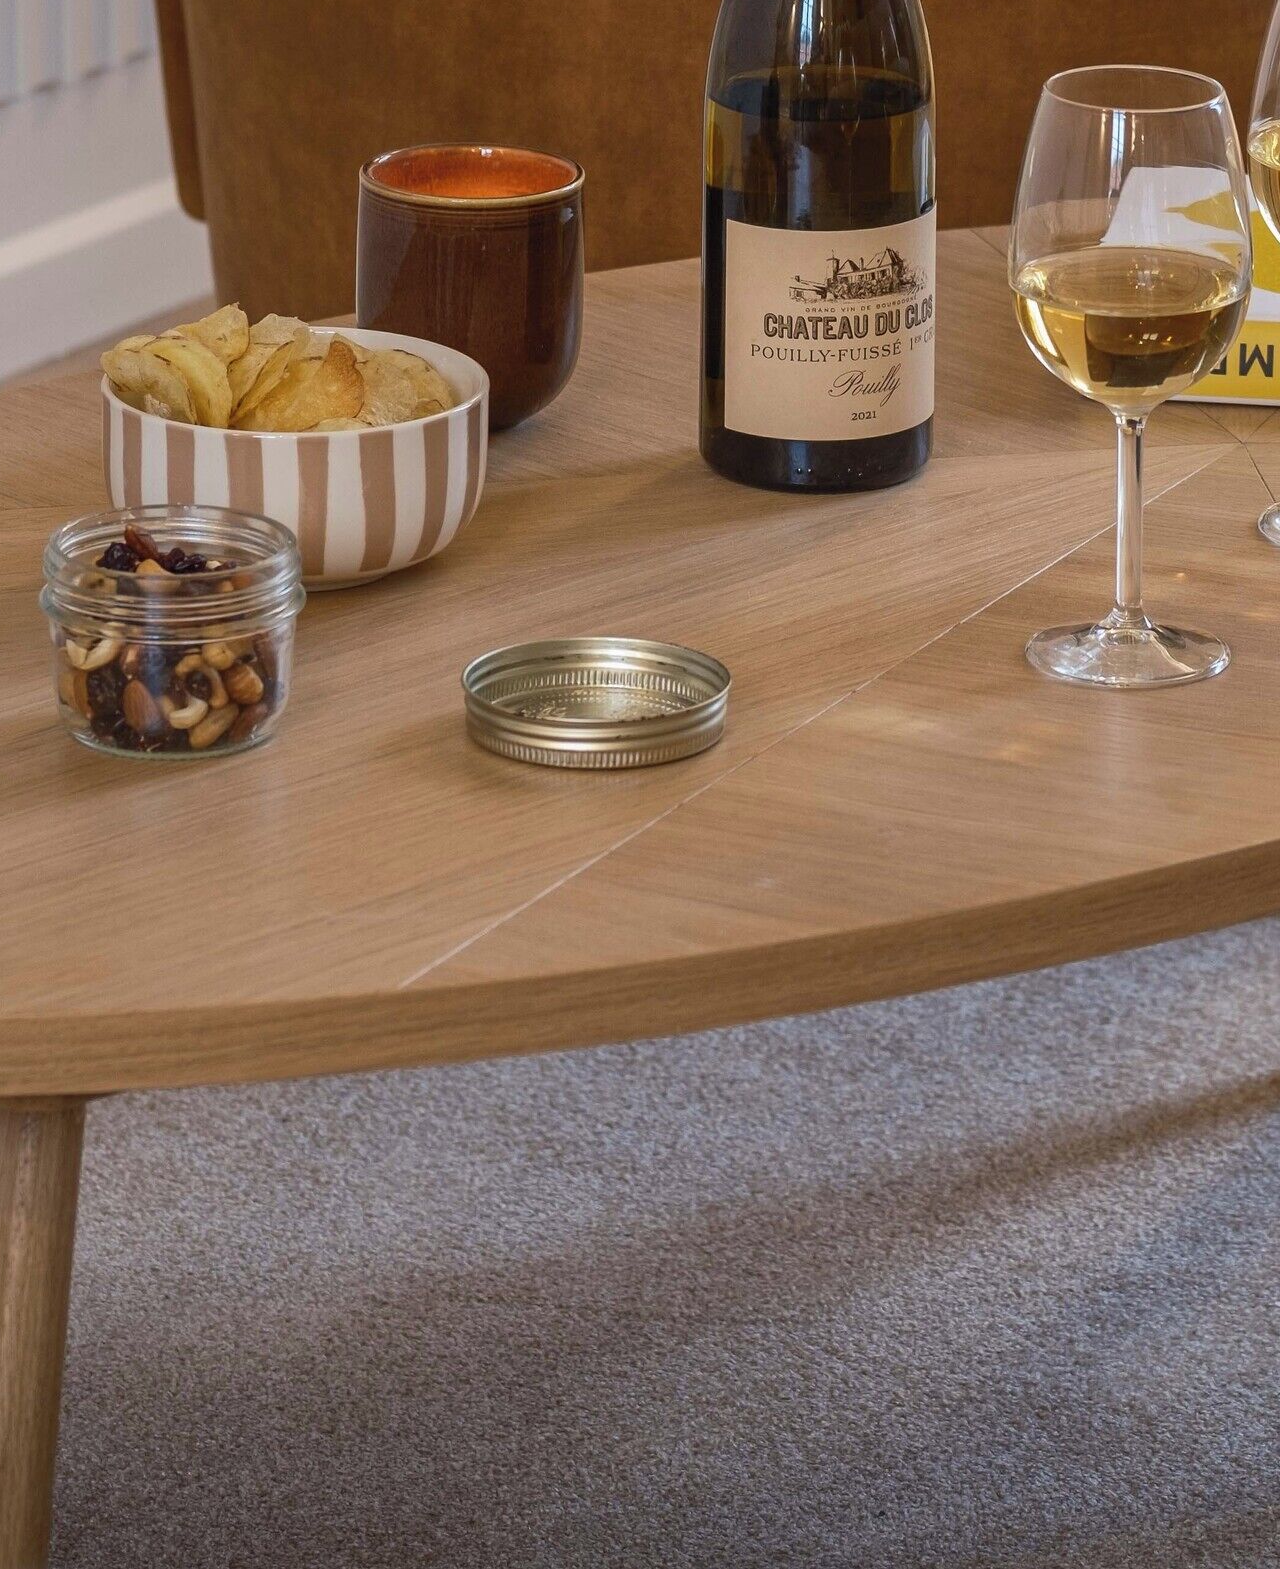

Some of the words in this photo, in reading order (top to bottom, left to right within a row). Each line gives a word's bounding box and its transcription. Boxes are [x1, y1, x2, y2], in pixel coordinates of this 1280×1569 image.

[763, 313, 869, 340] CHATEAU
[875, 309, 901, 336] DU
[905, 294, 933, 329] CLOS
[750, 338, 902, 363] POUILLY-FUISSÉ
[827, 363, 902, 407] Pouilly
[851, 410, 877, 421] 2021
